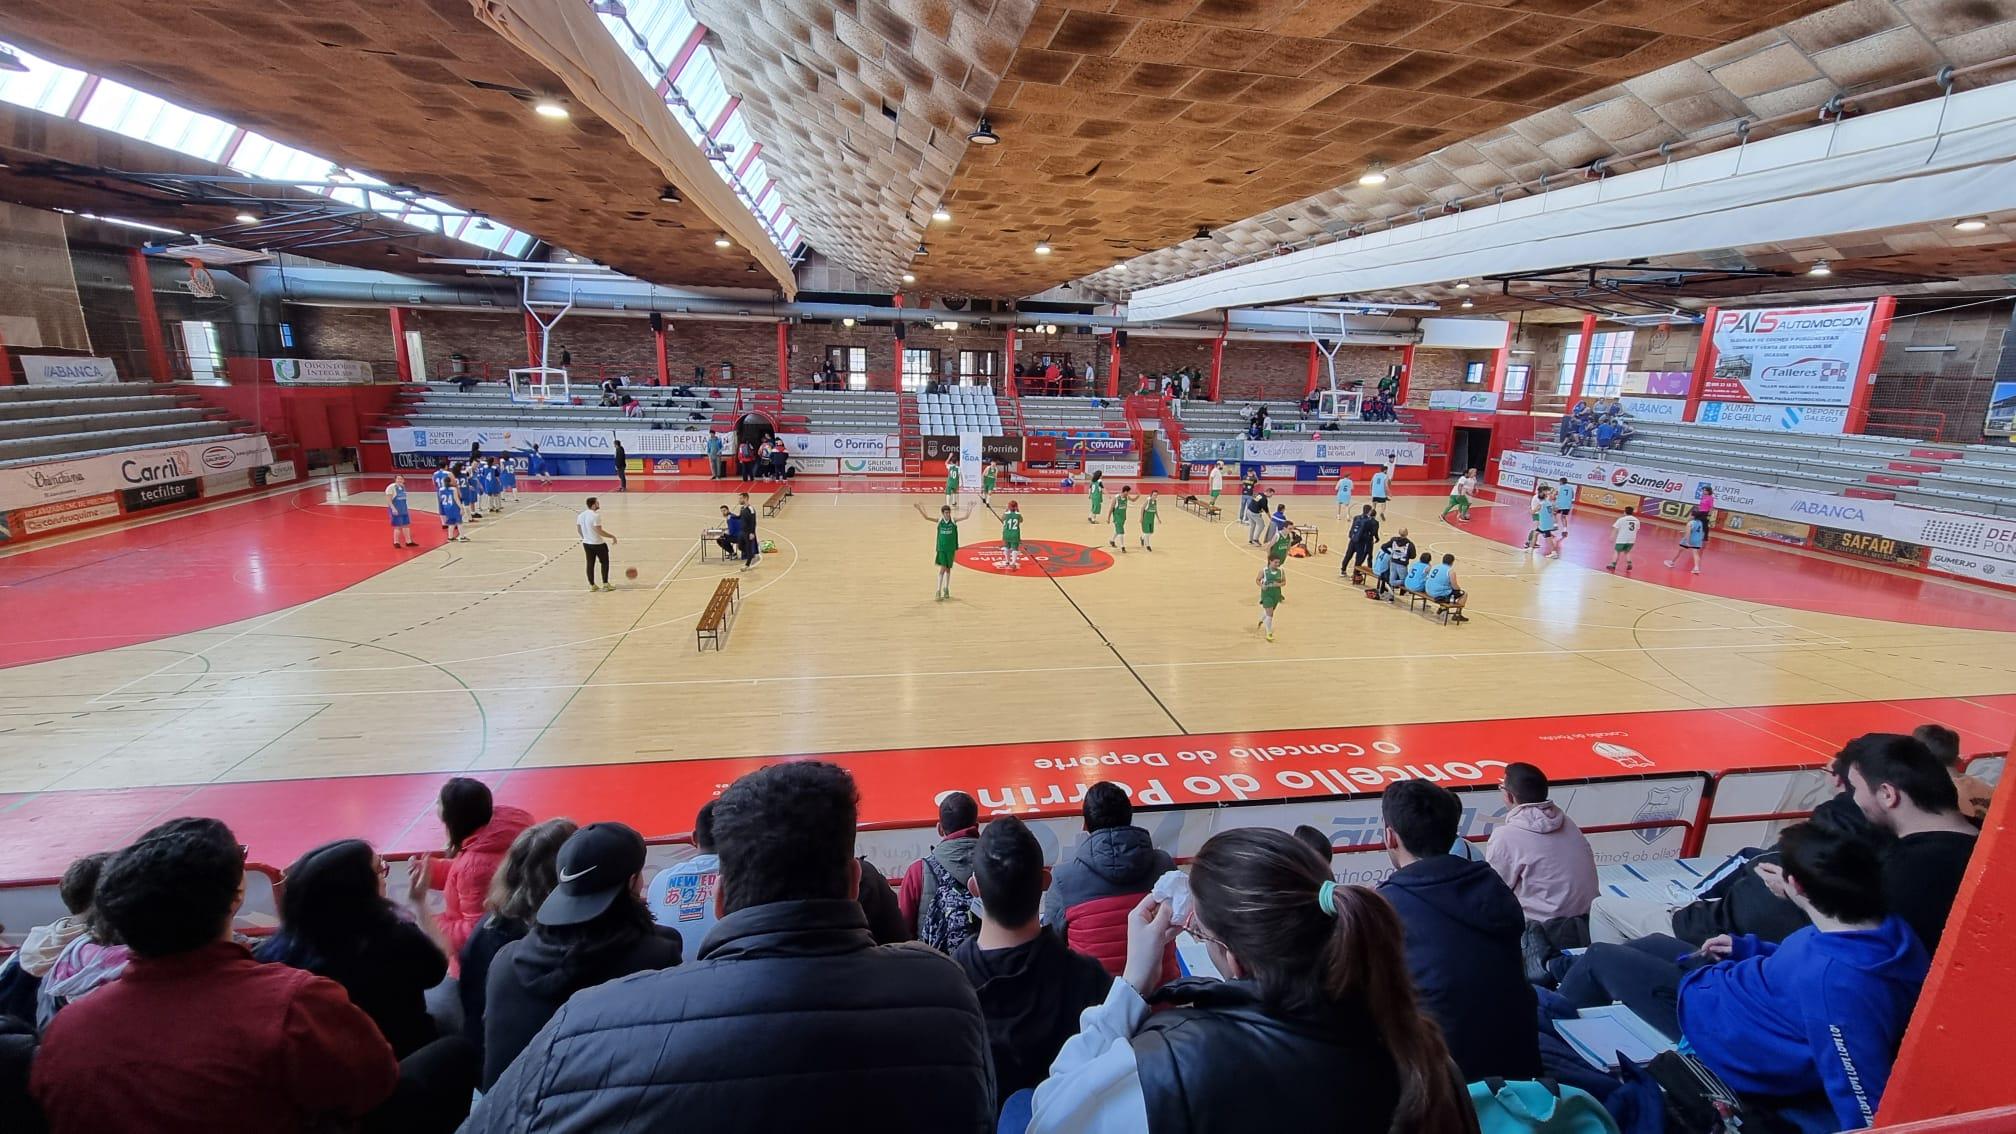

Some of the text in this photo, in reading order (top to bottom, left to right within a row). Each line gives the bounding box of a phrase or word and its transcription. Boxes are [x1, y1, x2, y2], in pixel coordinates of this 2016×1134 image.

[1716, 311, 1778, 334] PAIS
[1771, 368, 1817, 377] Talleres
[1724, 404, 1756, 413] XUNTA
[1806, 407, 1846, 417] DEPORTE
[1721, 412, 1771, 423] DE GALICIA
[1804, 415, 1838, 423] GALEGO
[987, 443, 1019, 454] Porriño
[1090, 439, 1124, 449] COVIGÁN
[1534, 456, 1565, 467] Conservas
[121, 457, 180, 484] Carril
[1552, 469, 1582, 480] Mariscos
[1628, 472, 1683, 493] Sumelga
[140, 484, 185, 501] tecfilter
[441, 494, 453, 505] 24
[1721, 494, 1754, 505] GALICIA
[1006, 518, 1019, 530] 12
[1628, 521, 1636, 532] 3
[1841, 532, 1896, 555] SAFARI
[1934, 555, 1977, 568] GUMERJO
[1409, 568, 1418, 579] 5
[1430, 568, 1439, 579] 9
[1034, 740, 1401, 771] O Concello do Deporte
[1182, 773, 1262, 801] do
[669, 875, 698, 888] NEW
